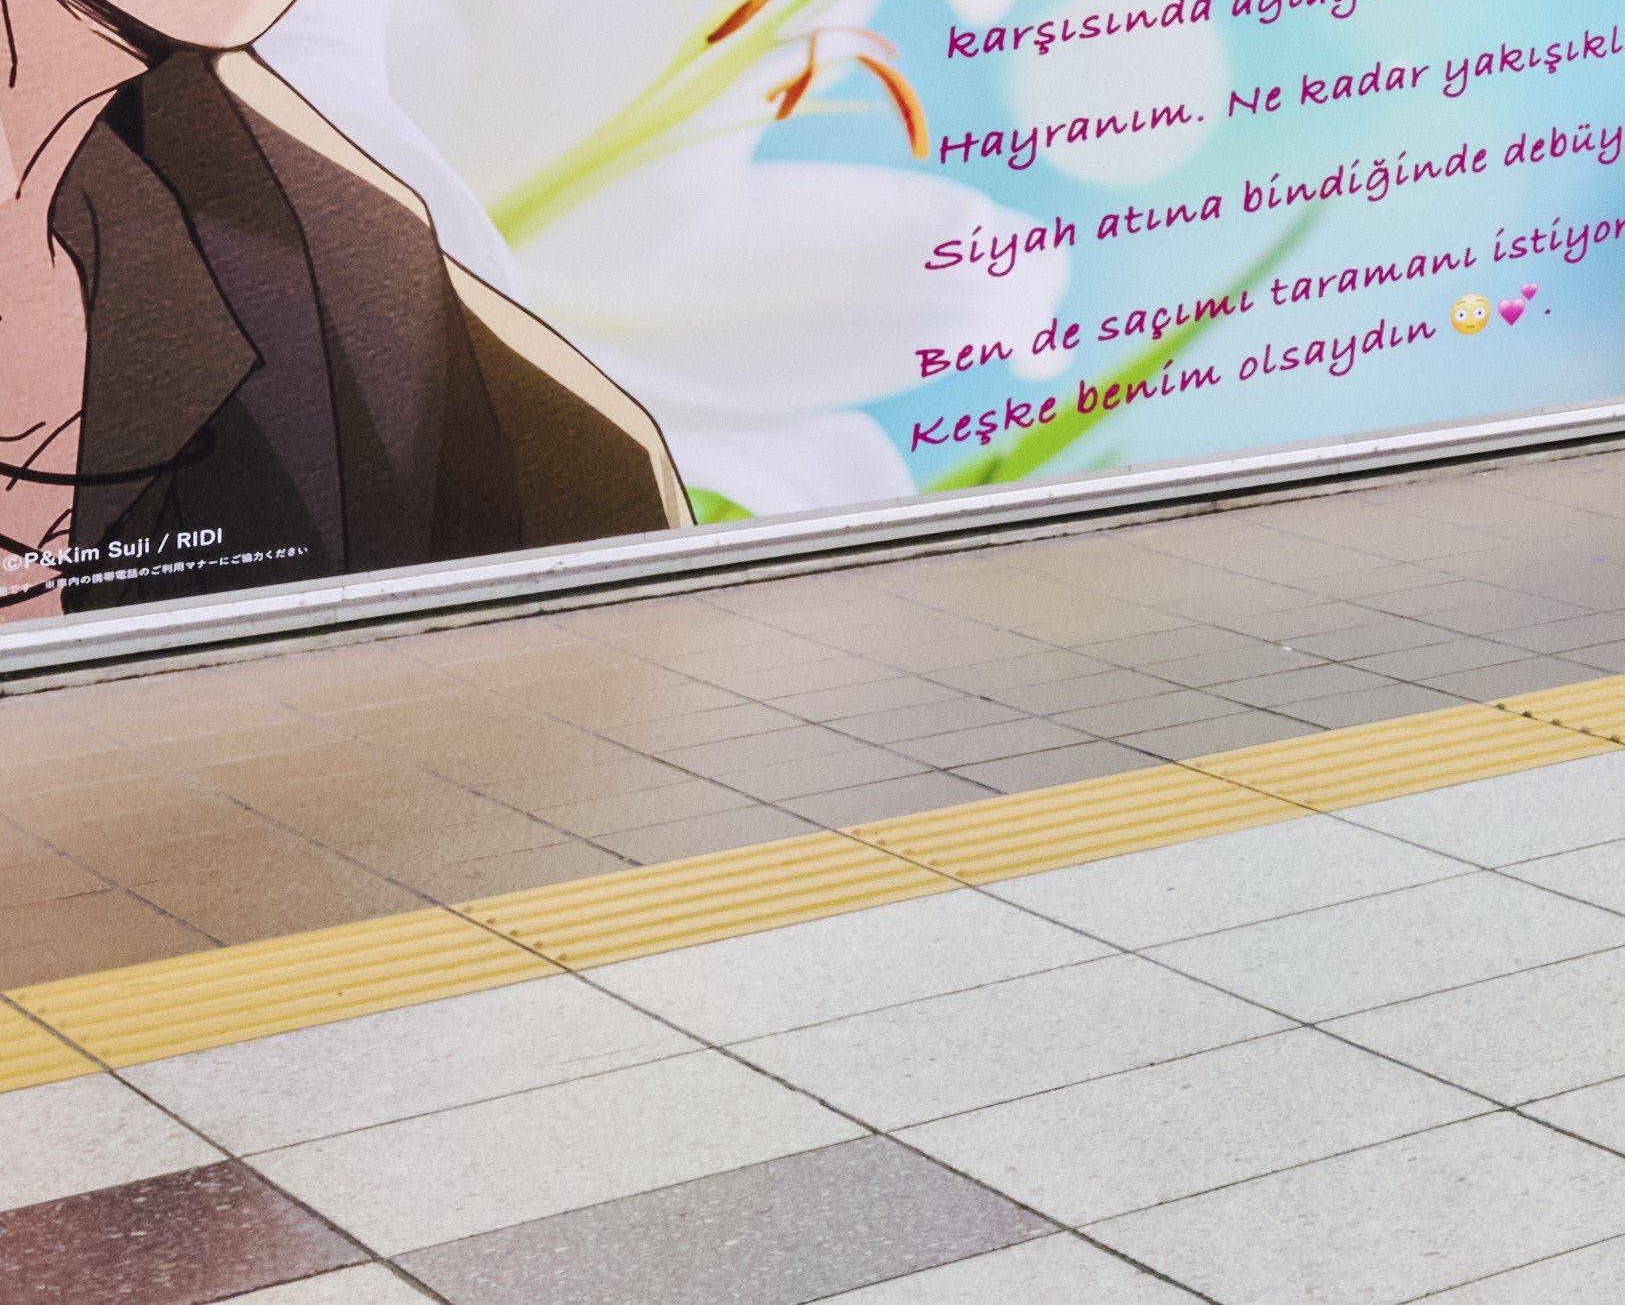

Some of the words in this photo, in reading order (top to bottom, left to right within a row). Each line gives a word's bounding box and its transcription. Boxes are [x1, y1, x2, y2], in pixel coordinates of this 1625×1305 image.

[940, 104, 1205, 170] Hayranım.
[1228, 86, 1281, 117] Ne
[1301, 61, 1429, 105] kadar
[923, 216, 1076, 278] Siyah
[1096, 196, 1223, 240] atına
[1243, 144, 1488, 215] bindiğinde
[915, 340, 1014, 378] Ben
[1032, 318, 1081, 355] de
[1098, 291, 1254, 341] saçımı
[1271, 247, 1477, 306] taramanı
[910, 396, 1057, 452] Keşke
[1077, 360, 1222, 413] benim
[1239, 316, 1437, 381] olsaydın
[108, 538, 150, 560] Suji
[157, 533, 169, 553] /
[177, 528, 222, 550] RIDI
